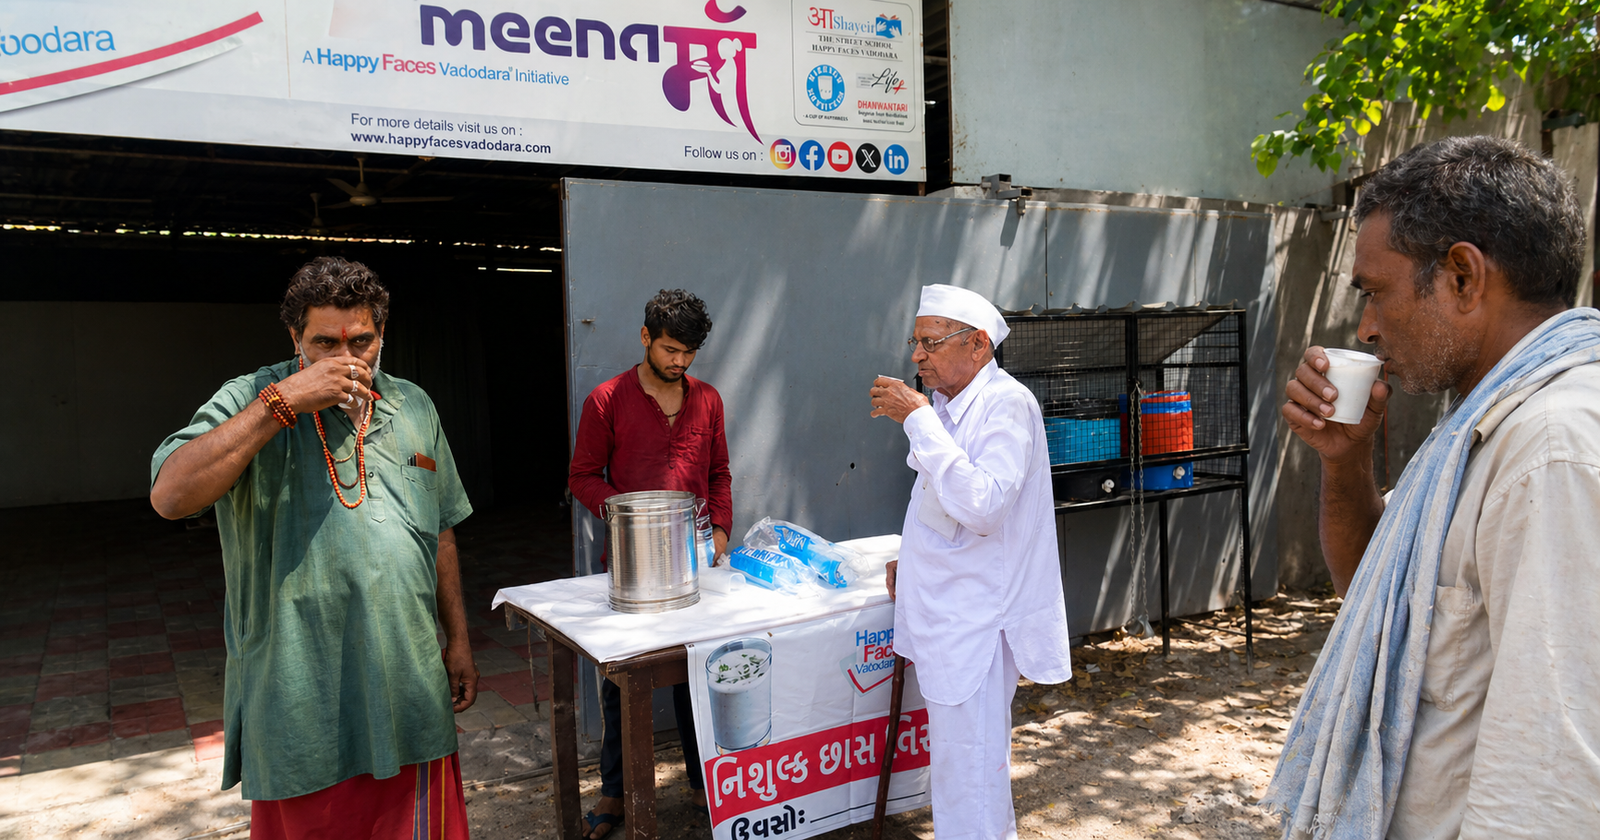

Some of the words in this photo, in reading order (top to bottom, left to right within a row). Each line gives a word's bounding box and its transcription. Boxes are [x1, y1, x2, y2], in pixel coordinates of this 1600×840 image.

[302, 50, 315, 64] A
[316, 48, 379, 74] Happy
[382, 53, 437, 75] Faces
[515, 68, 570, 86] Initiative
[857, 100, 908, 112] DHANWANTARI
[350, 113, 373, 126] For
[377, 117, 410, 129] more
[414, 118, 454, 132] details
[457, 121, 481, 134] visit
[484, 125, 498, 135] us
[501, 126, 516, 136] on
[350, 132, 551, 154] www.happyfacesvadodara.com
[684, 145, 722, 159] Follow
[725, 150, 739, 160] us
[742, 151, 757, 161] on
[856, 628, 894, 647] Happ
[864, 643, 896, 663] Fac
